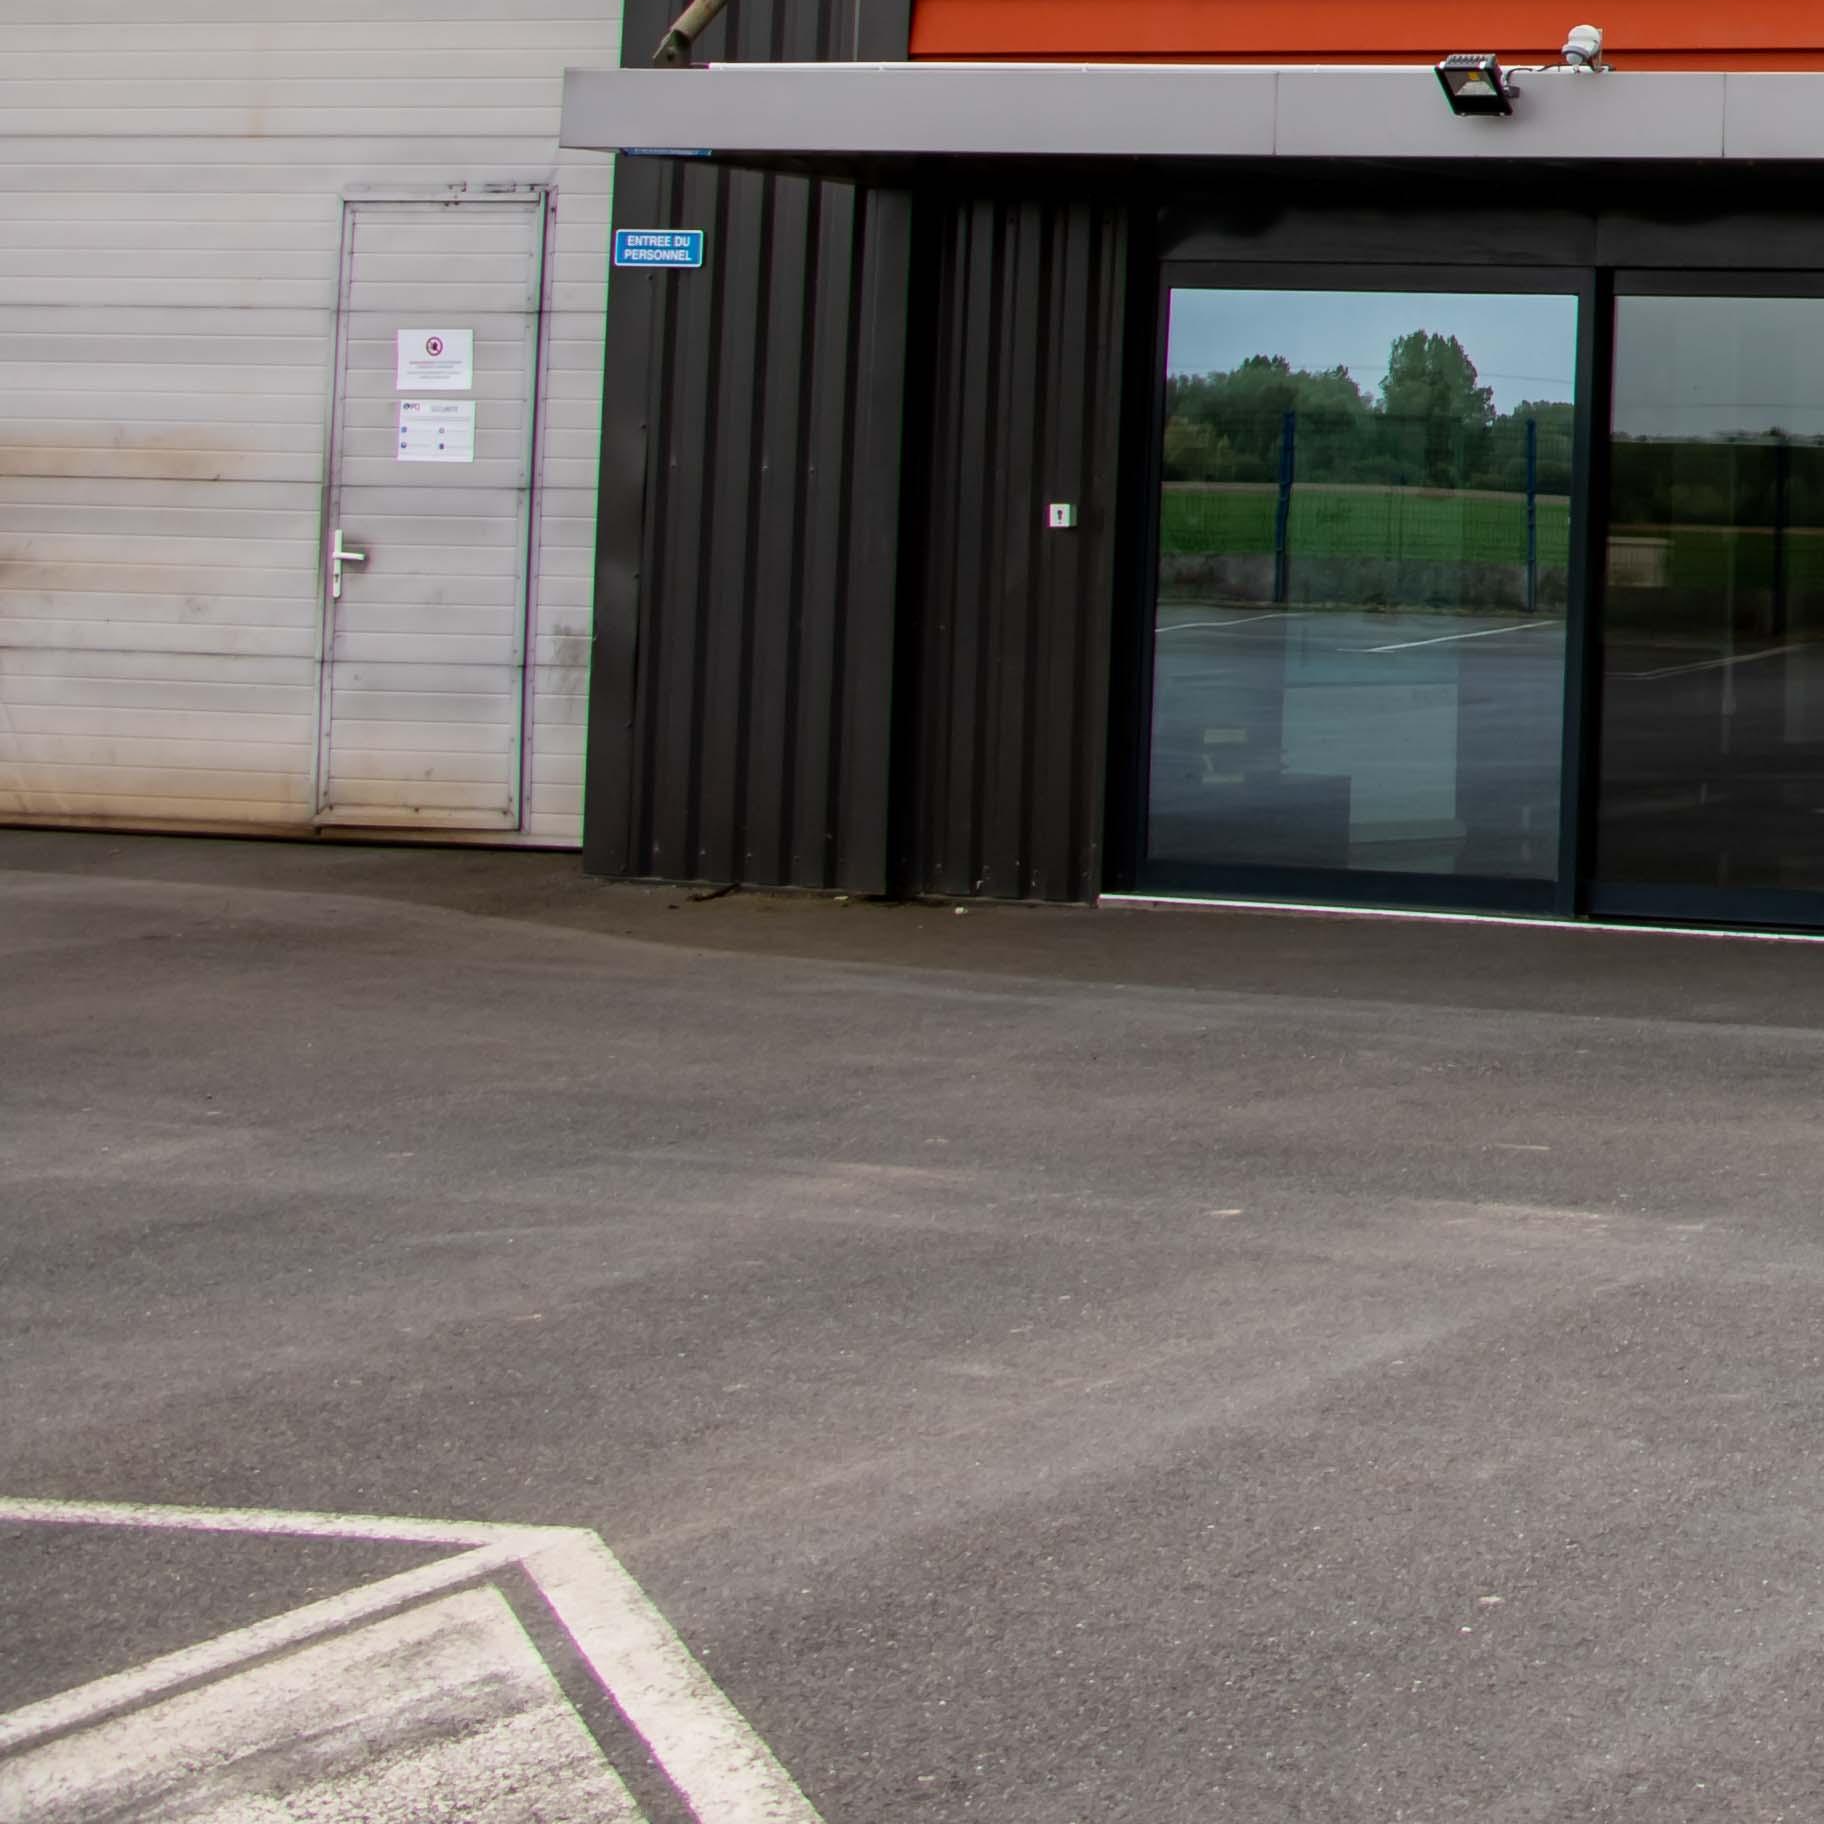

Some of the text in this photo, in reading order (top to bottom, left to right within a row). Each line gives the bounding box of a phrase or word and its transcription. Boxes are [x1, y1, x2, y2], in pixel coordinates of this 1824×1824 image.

[627, 235, 691, 247] ENTREE DU
[624, 249, 692, 261] PERSONNEL
